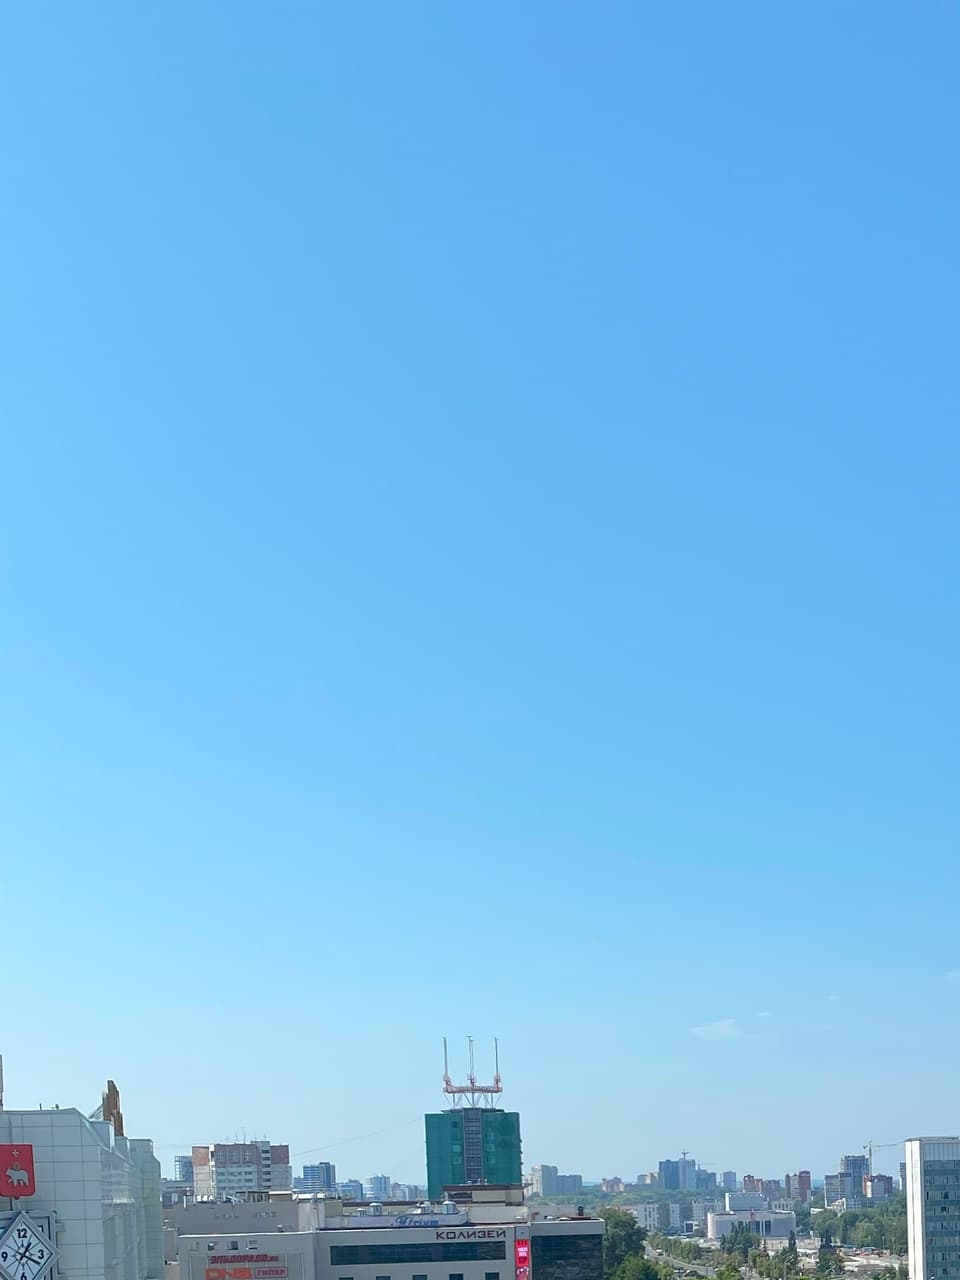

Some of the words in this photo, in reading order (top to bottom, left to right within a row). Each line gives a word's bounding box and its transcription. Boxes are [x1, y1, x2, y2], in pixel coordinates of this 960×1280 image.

[16, 1228, 28, 1238] 12
[1, 1251, 8, 1262] 9
[38, 1249, 44, 1259] 3
